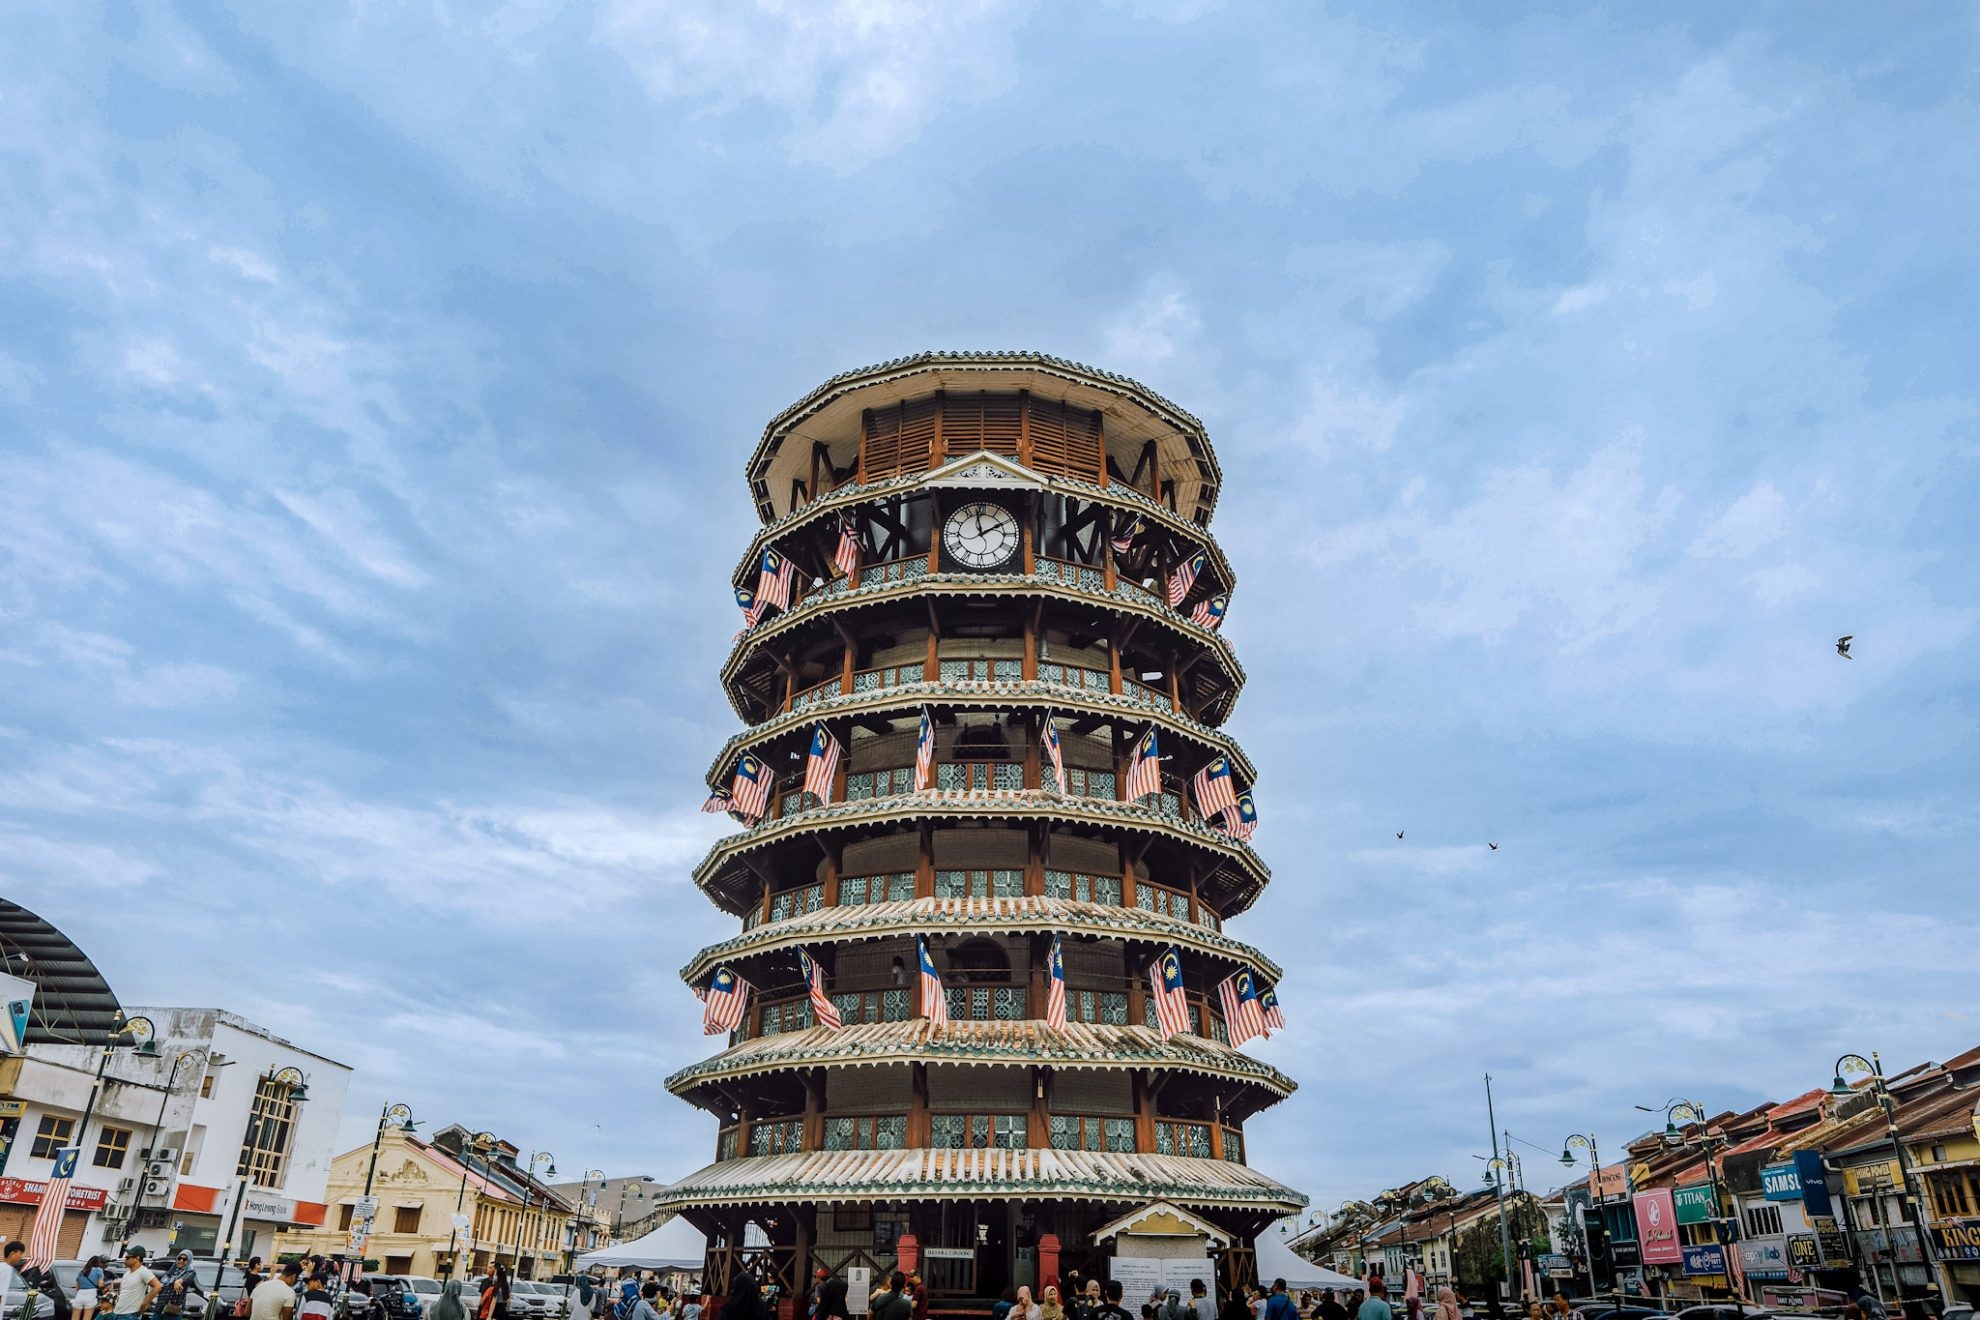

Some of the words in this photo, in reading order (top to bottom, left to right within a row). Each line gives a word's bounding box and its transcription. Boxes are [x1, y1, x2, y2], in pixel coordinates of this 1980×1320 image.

[23, 1182, 47, 1194] SHAN
[67, 1188, 102, 1200] TOMETRIST
[1683, 1191, 1706, 1206] TITAN
[1941, 1226, 1980, 1247] KING
[1793, 1241, 1815, 1256] ONE
